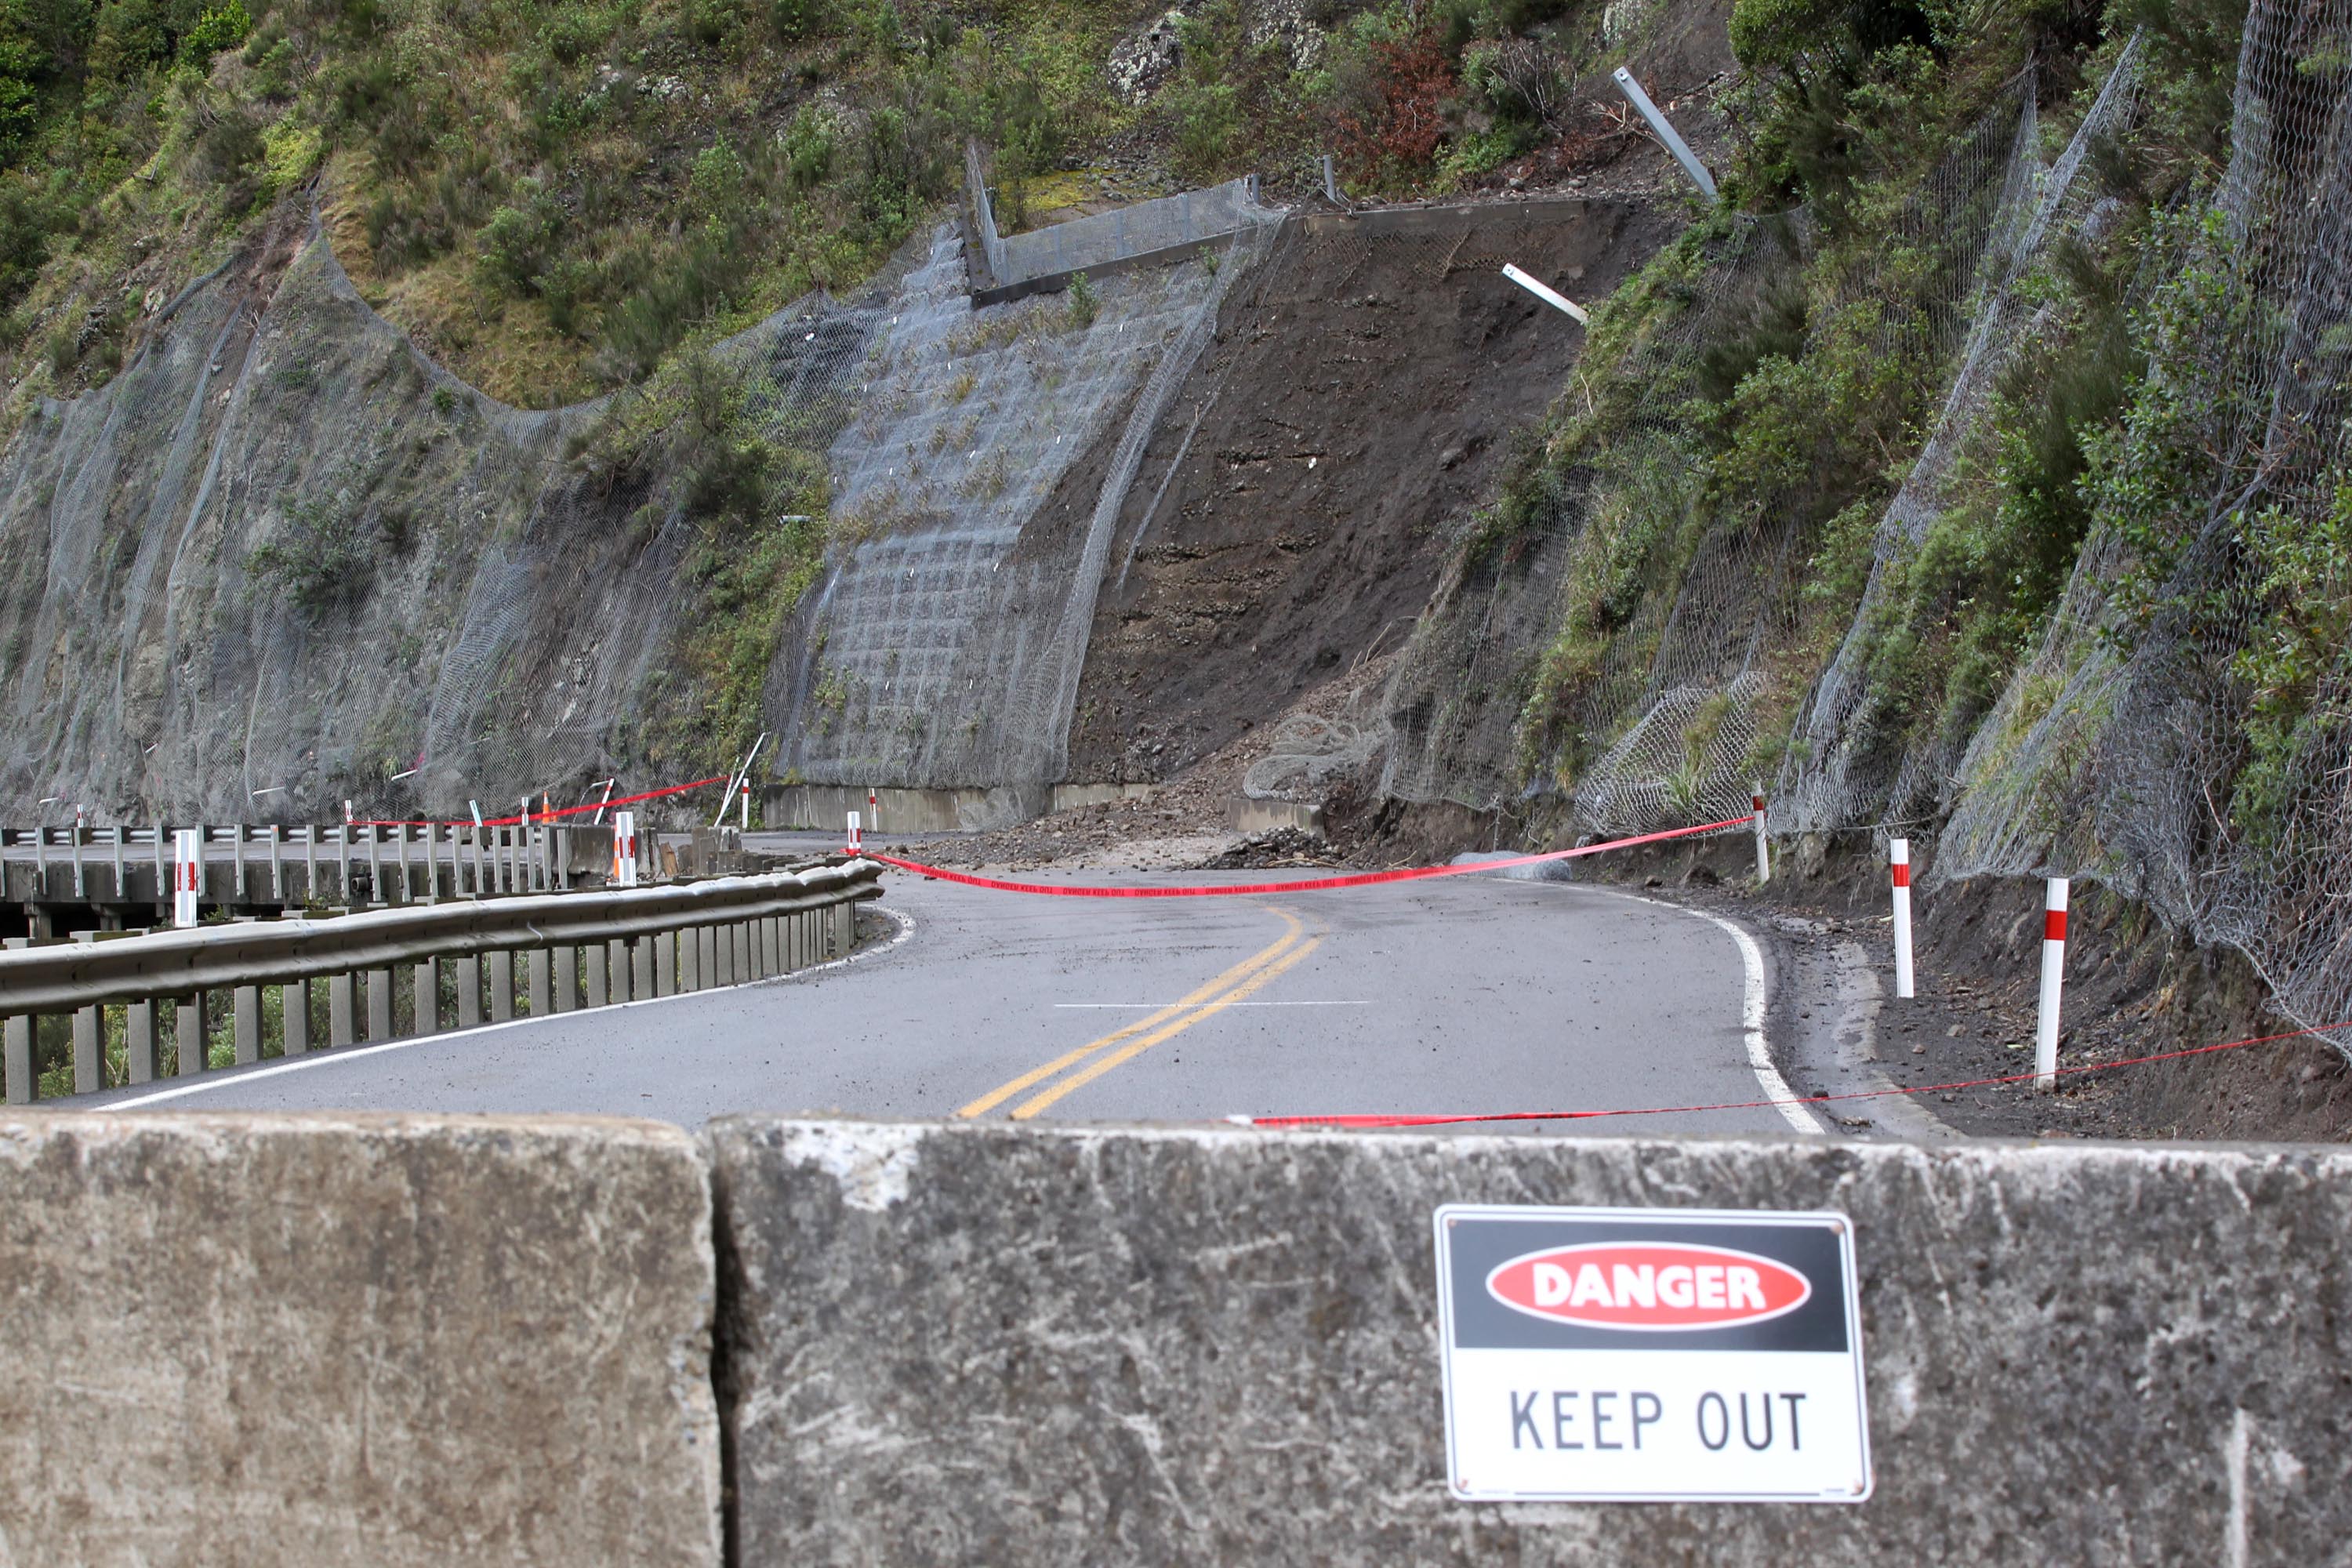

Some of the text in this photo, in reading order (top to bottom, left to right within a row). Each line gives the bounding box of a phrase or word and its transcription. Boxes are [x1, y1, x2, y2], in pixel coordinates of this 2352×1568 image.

[1532, 1262, 1766, 1309] DANGER
[1510, 1391, 1807, 1451] KEEP OUT
